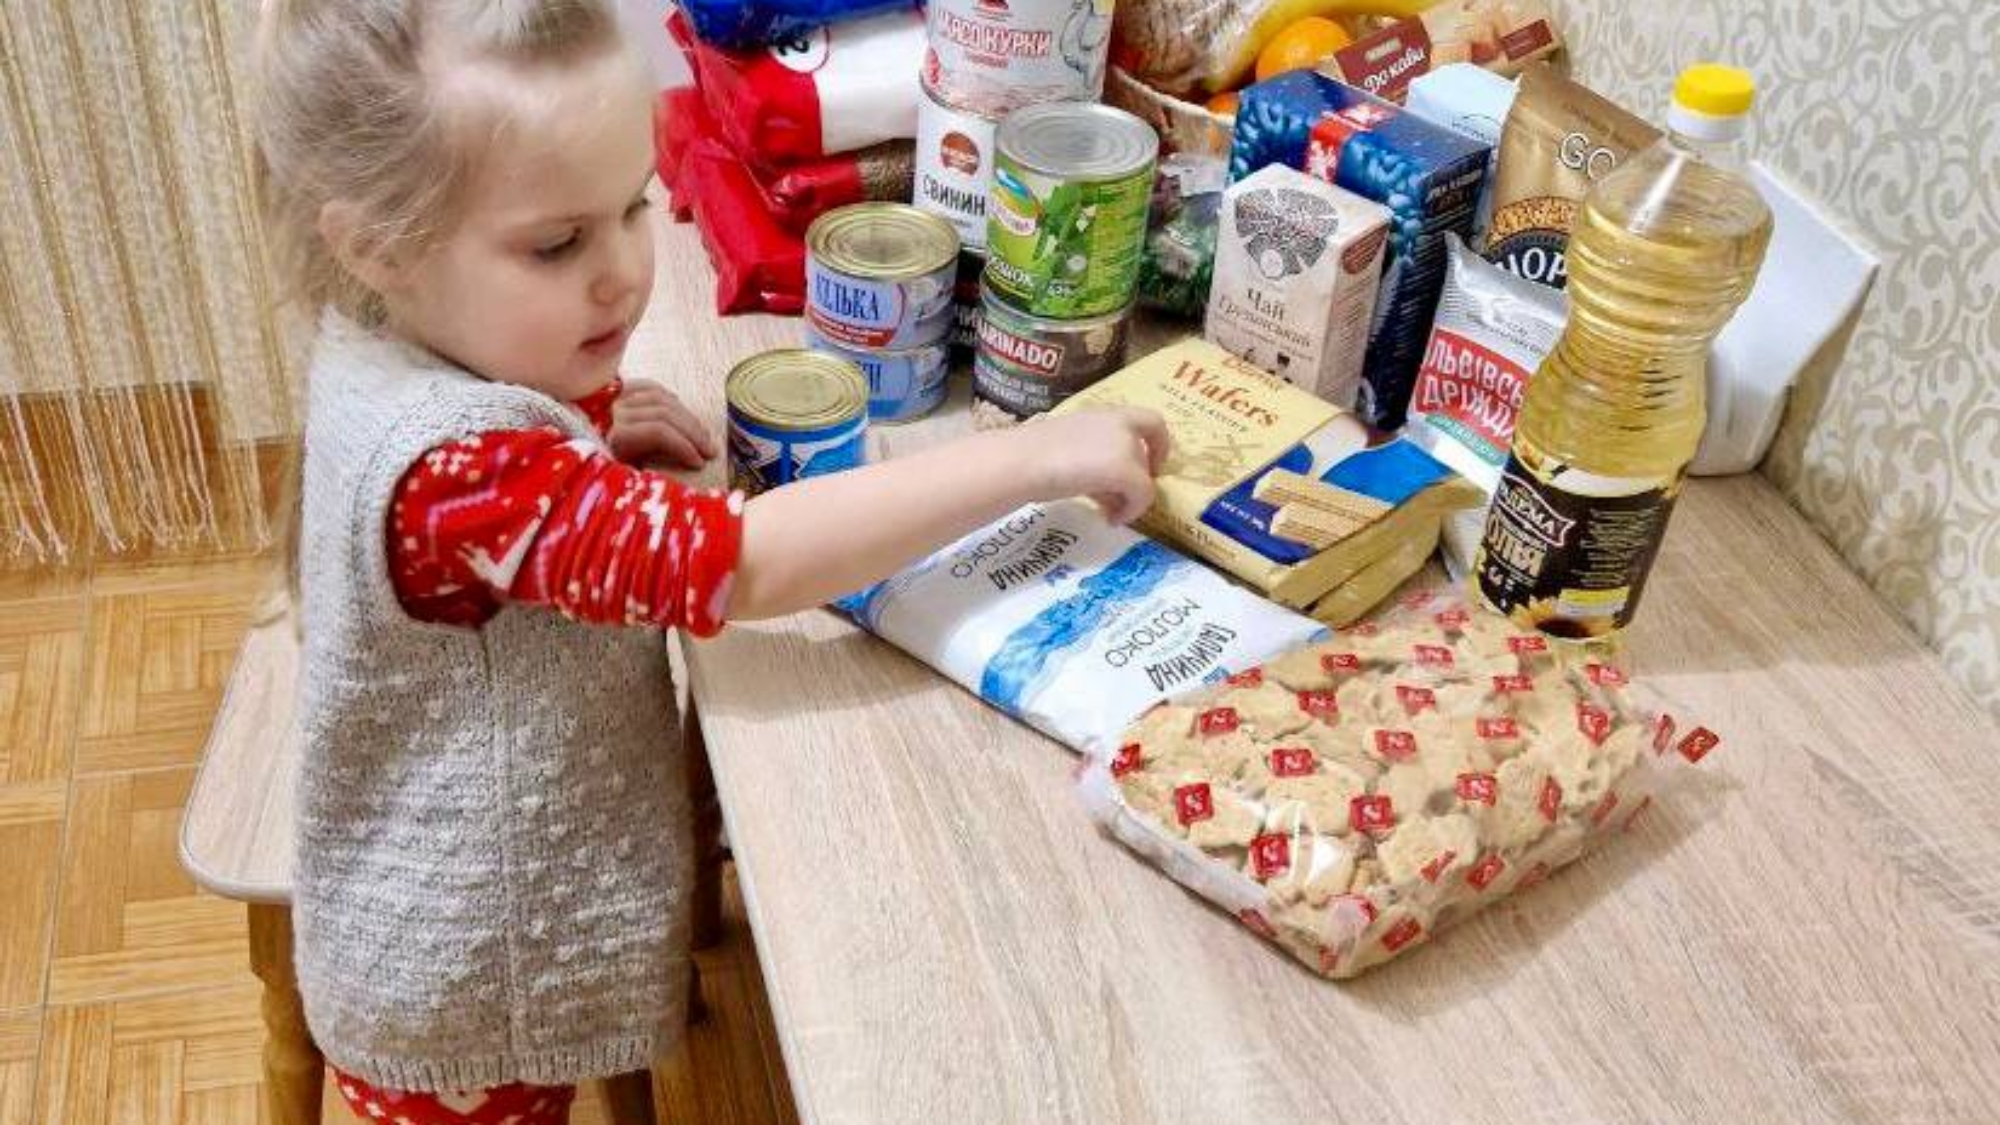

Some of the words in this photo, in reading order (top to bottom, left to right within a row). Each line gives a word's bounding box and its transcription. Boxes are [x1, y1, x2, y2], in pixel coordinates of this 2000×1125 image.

[985, 26, 1051, 56] КУРКИ
[1247, 287, 1285, 321] Чай
[1173, 360, 1280, 427] Wafers
[1104, 597, 1202, 668] МОЛОКО
[1144, 622, 1238, 693] ГАЛИЧИНА
